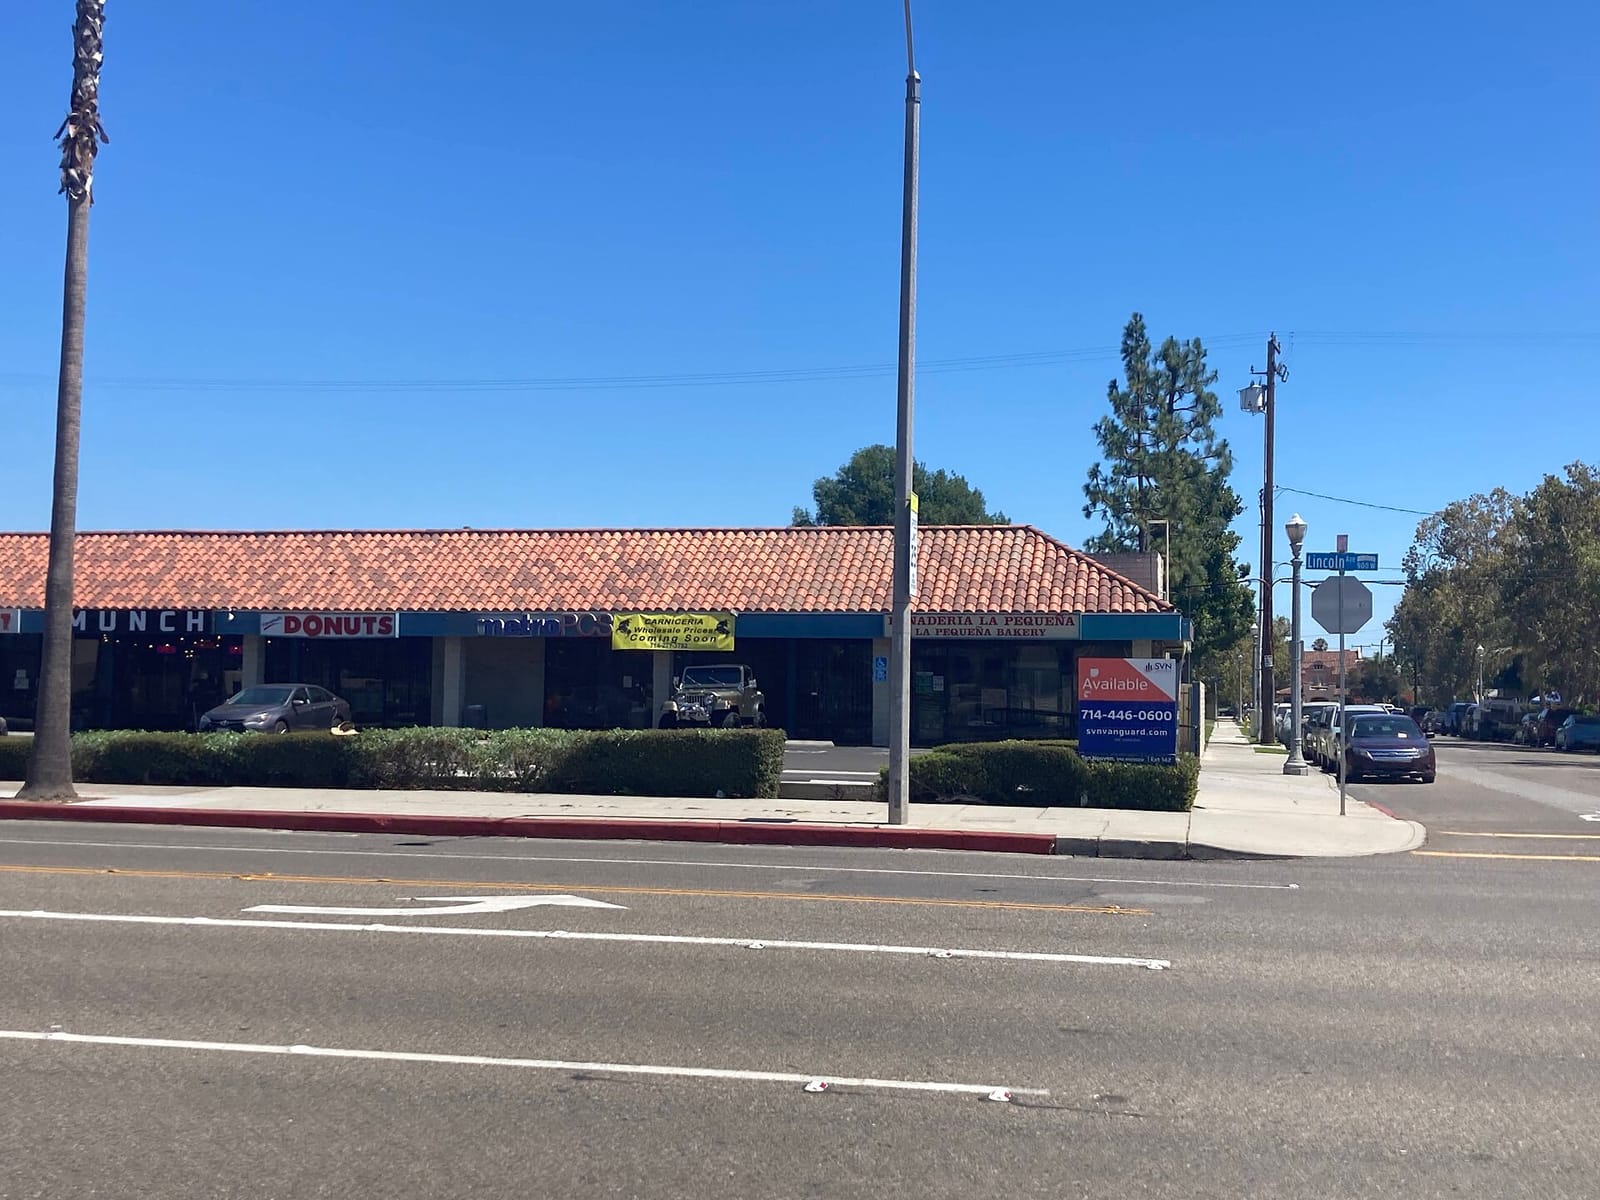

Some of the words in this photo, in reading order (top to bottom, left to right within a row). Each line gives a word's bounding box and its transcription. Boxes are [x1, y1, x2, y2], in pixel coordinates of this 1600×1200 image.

[1308, 555, 1345, 569] Lincoln
[72, 611, 204, 631] MUNCH
[284, 615, 393, 635] DONUTS
[643, 617, 703, 625] CARNICERIA
[888, 616, 970, 626] NADERIA
[979, 616, 998, 626] LA
[1004, 614, 1074, 626] PEQUEÑA
[632, 625, 679, 634] Wholesale
[915, 628, 930, 636] LA
[935, 626, 990, 636] PEQUEÑA
[997, 628, 1046, 636] BAKERY
[629, 632, 677, 643] Coming
[684, 632, 717, 642] Soon
[1082, 678, 1148, 690] Available
[1081, 710, 1172, 721] 714-446-0600
[1086, 729, 1168, 737] svnvanguard.com
